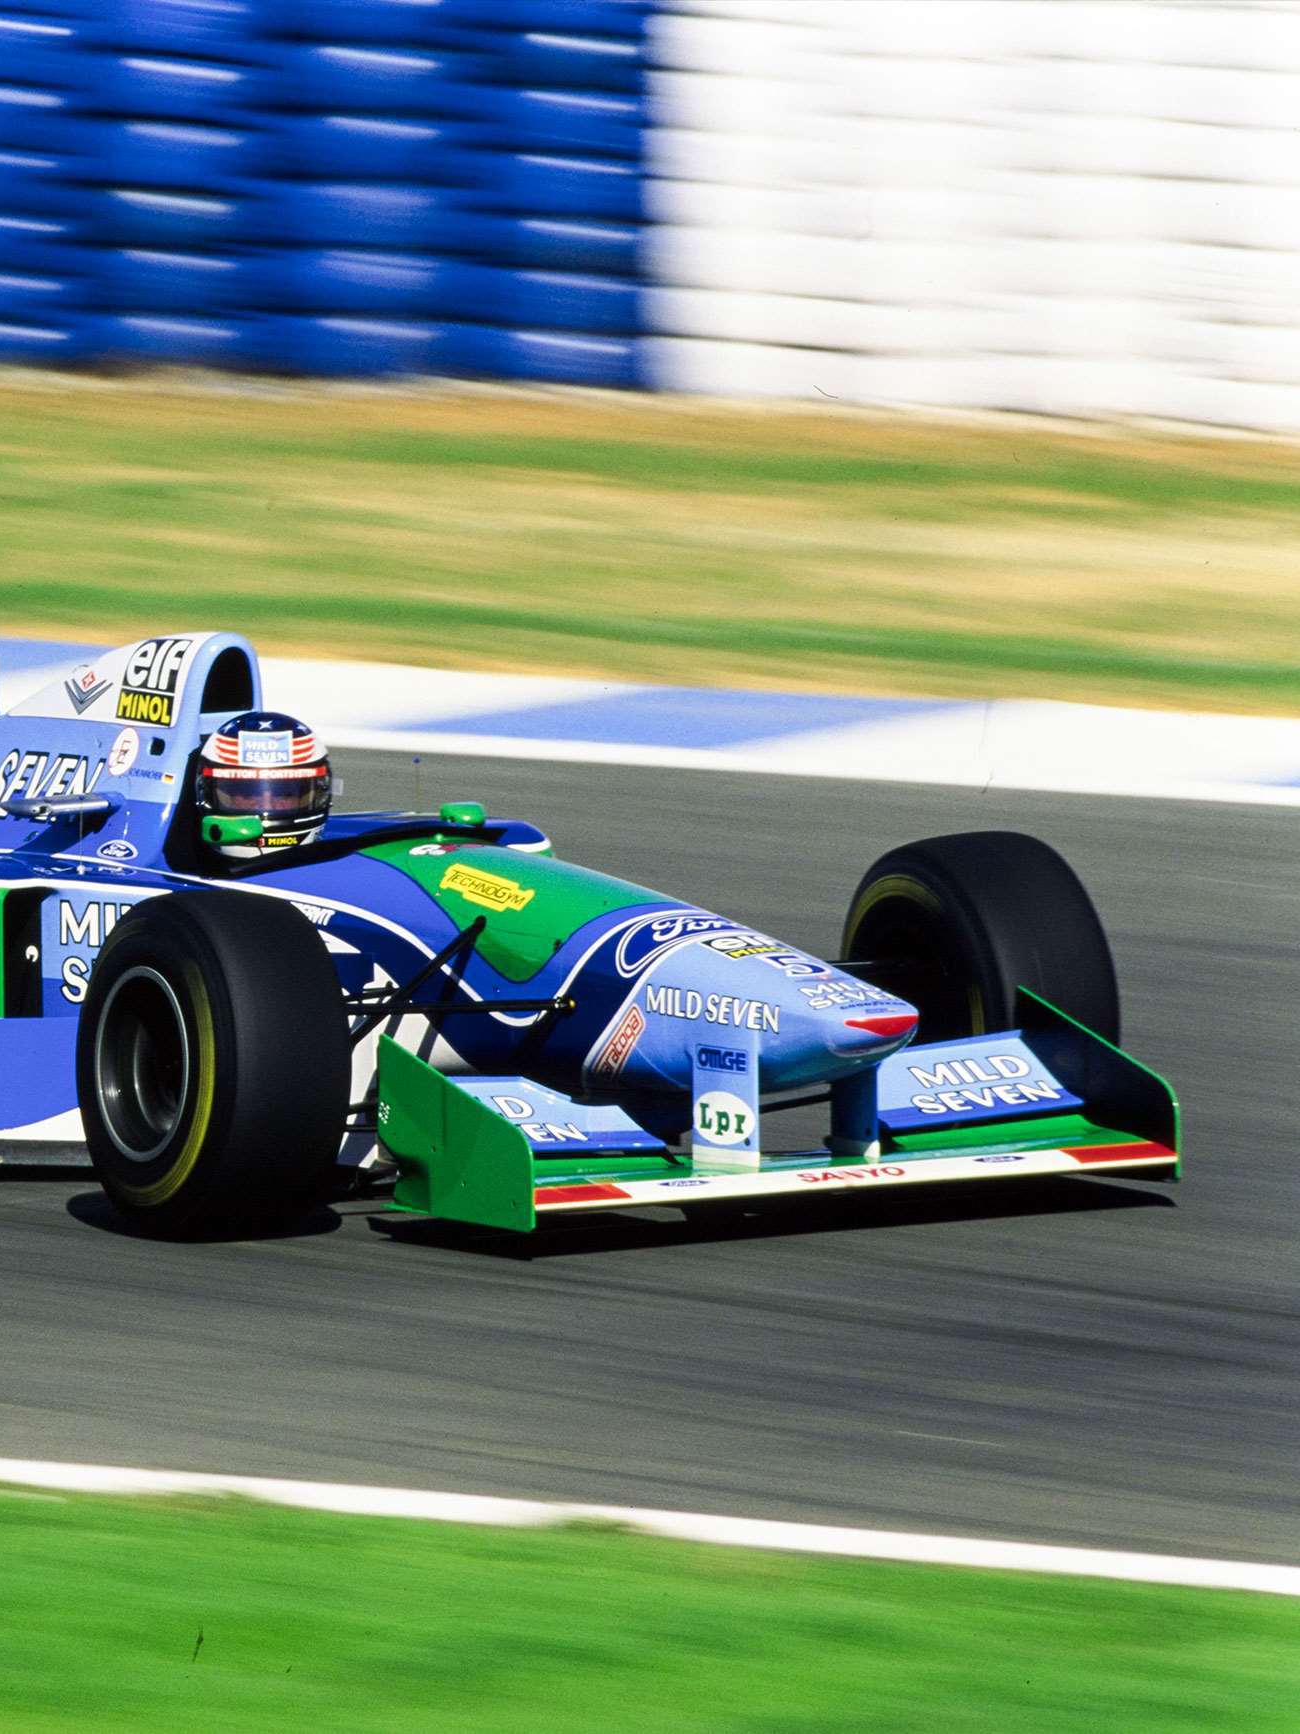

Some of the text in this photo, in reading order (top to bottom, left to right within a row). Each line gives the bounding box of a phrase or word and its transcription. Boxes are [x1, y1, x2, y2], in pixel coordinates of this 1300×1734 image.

[126, 639, 193, 690] elf
[117, 691, 171, 724] MINOL
[243, 740, 280, 750] MILD
[244, 751, 288, 762] SEVEN
[267, 837, 298, 846] MINOL
[60, 899, 132, 947] MI
[758, 954, 831, 977] 5
[645, 984, 780, 1034] MILD SEVEN
[908, 1055, 1032, 1089] MILD
[911, 1080, 1062, 1114] SEVEN
[700, 1103, 746, 1135] Lpr
[797, 1166, 905, 1183] SANYO
